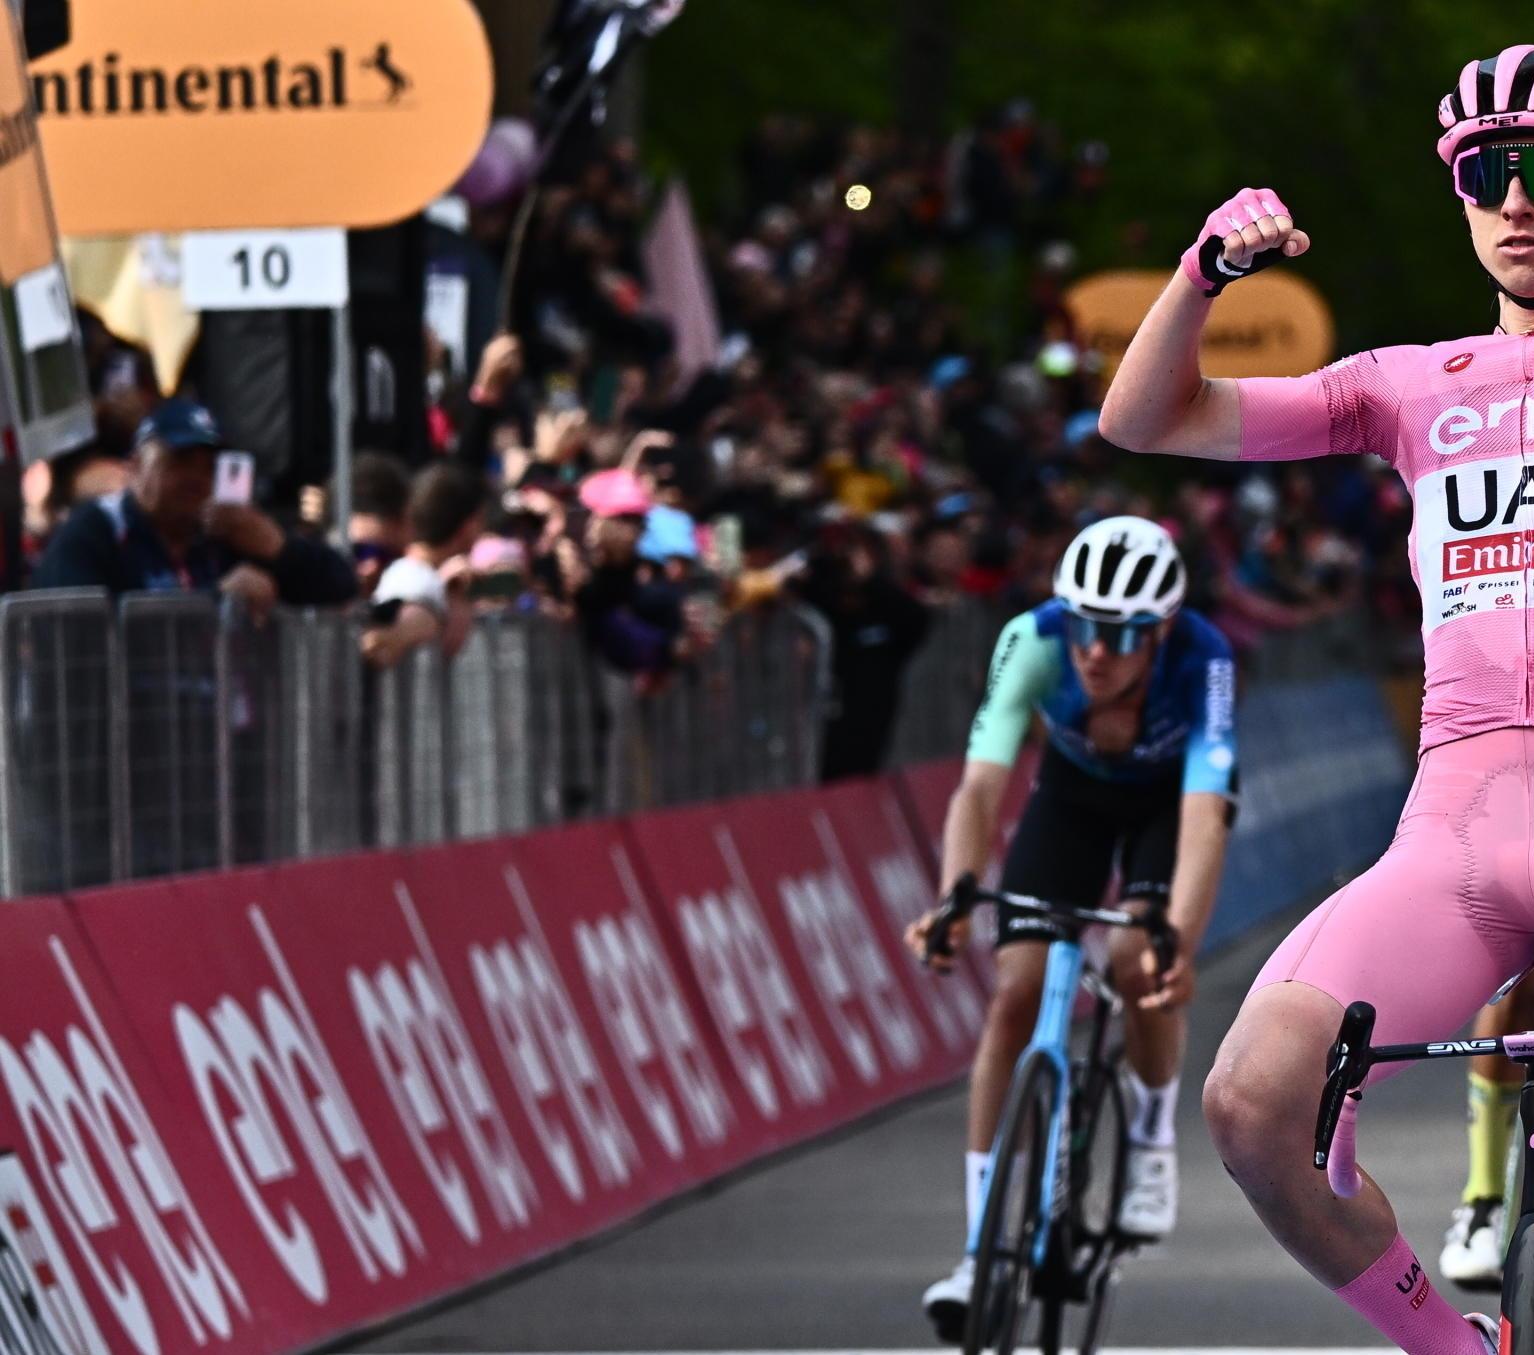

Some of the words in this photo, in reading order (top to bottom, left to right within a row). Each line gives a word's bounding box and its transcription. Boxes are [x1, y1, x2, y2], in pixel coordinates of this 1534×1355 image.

[33, 47, 348, 115] ntinental
[1478, 114, 1523, 128] MET
[230, 244, 291, 291] 10
[1487, 580, 1519, 589] PISSEI
[347, 877, 541, 1247] enel
[172, 904, 429, 1306] enel
[1395, 1254, 1421, 1294] UA
